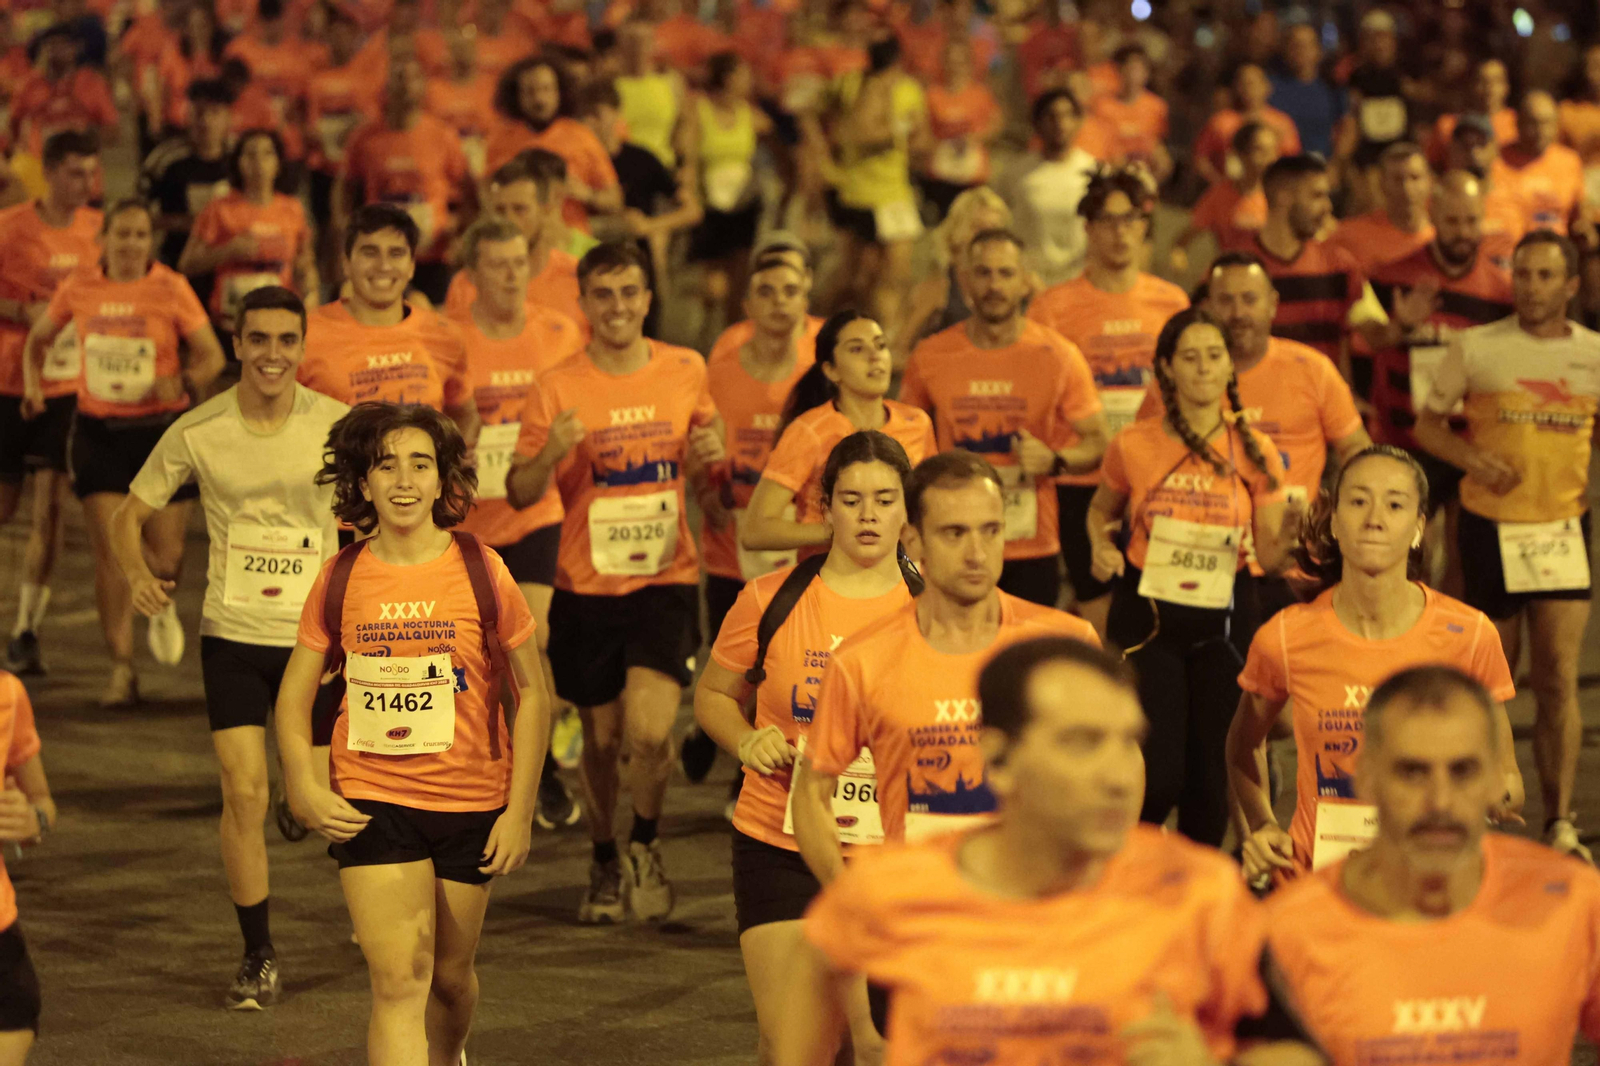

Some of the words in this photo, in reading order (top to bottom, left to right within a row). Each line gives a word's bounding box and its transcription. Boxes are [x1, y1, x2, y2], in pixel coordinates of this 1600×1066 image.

[608, 523, 664, 541] 20326
[244, 555, 303, 575] 22026
[1170, 551, 1218, 571] 5838
[379, 600, 436, 620] XXXV
[356, 622, 399, 631] CARRERA
[403, 621, 456, 629] NOCTURNA
[362, 630, 456, 642] GUADALQUIVIR
[363, 692, 433, 712] 21462
[909, 725, 960, 736] CARRERA
[1393, 994, 1487, 1033] XXXV
